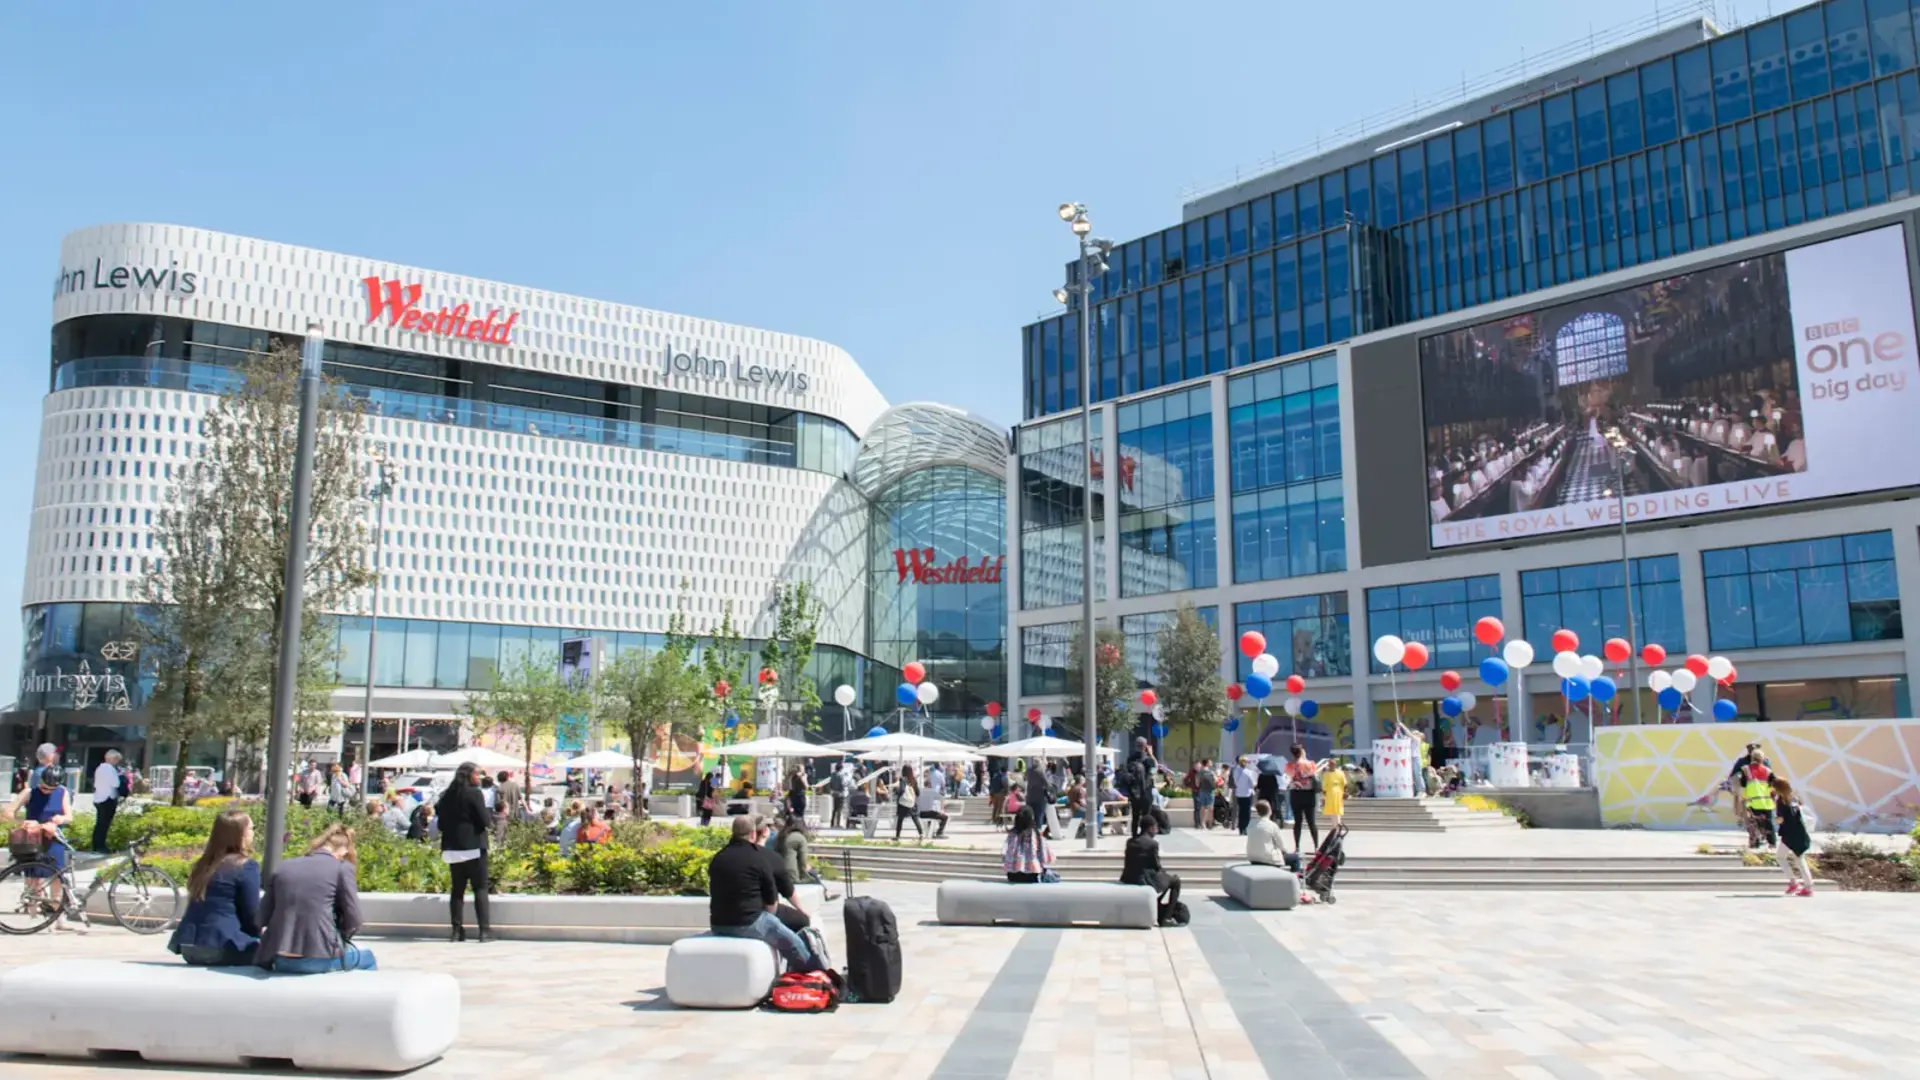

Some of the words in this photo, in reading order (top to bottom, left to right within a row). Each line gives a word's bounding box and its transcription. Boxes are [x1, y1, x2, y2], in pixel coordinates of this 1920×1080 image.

[93, 257, 197, 294] Lewis
[362, 275, 520, 345] Westfield
[1805, 318, 1860, 341] BBC
[662, 343, 726, 378] John
[736, 354, 809, 391] Lewis
[1806, 331, 1906, 373] one
[1811, 378, 1850, 400] big
[1855, 371, 1908, 392] day
[1443, 521, 1486, 541] THE
[1498, 511, 1574, 534] ROYAL
[1586, 492, 1710, 521] WEDDING
[1725, 480, 1791, 505] LIVE
[892, 546, 1006, 585] Westfield
